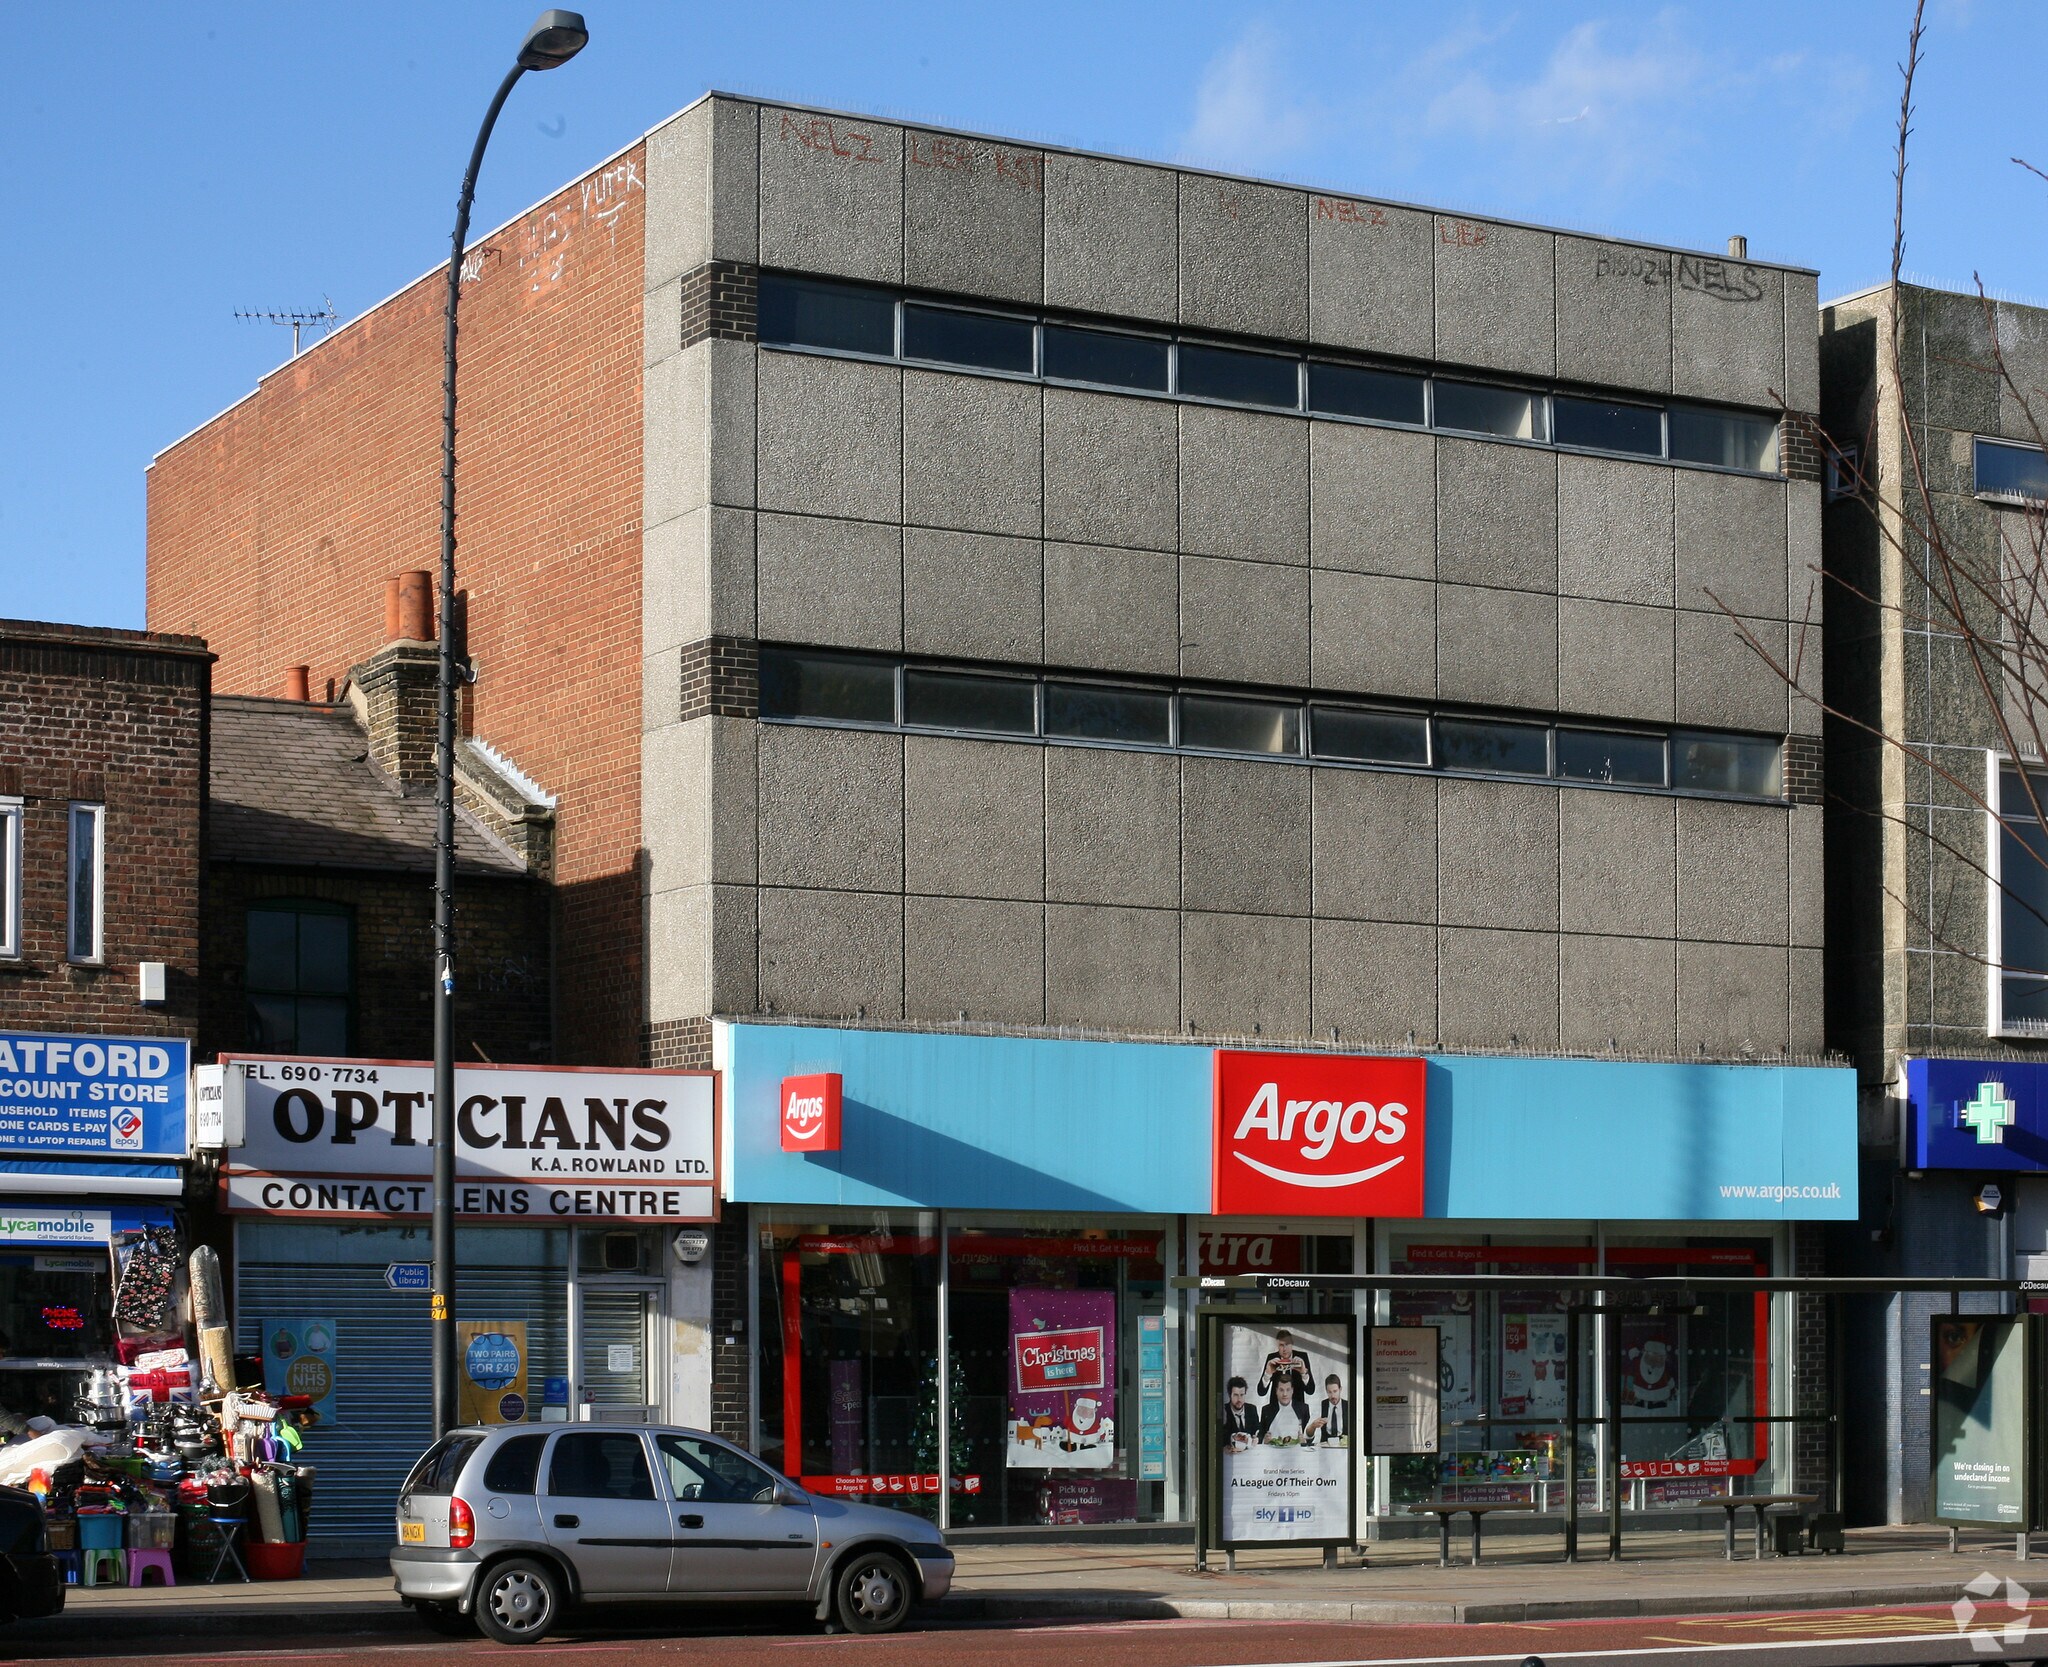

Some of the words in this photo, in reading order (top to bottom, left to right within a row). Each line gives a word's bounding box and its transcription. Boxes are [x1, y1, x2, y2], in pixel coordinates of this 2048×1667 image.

[0, 1040, 170, 1079] ATFORD
[244, 1064, 276, 1080] EL.
[0, 1079, 82, 1100] COUNT
[88, 1082, 169, 1103] STORE
[69, 1108, 107, 1118] ITEMS
[786, 1091, 823, 1127] Argos
[273, 1087, 672, 1152] OPTCIANS
[1233, 1082, 1409, 1160] Argos
[28, 1121, 70, 1131] CARDS
[73, 1123, 108, 1133] E-PAY
[27, 1136, 65, 1145] LAPTOP
[67, 1137, 107, 1146] REPAIRS
[115, 1138, 139, 1147] epay
[572, 1157, 666, 1174] ROWLAND
[675, 1159, 709, 1174] LTD.
[1719, 1182, 1842, 1203] www.argos.co.uk
[262, 1182, 426, 1212] CONTACT
[549, 1189, 681, 1216] CENTRE
[0, 1216, 95, 1233] Lycamobile
[1073, 1243, 1089, 1252] Find
[1099, 1243, 1112, 1252] Get
[1122, 1245, 1143, 1255] Argos
[1411, 1250, 1427, 1258] Find
[1436, 1250, 1448, 1258] Get
[1457, 1250, 1476, 1259] Argos
[45, 1258, 95, 1268] Lycamobile
[399, 1268, 425, 1276] Public
[398, 1277, 425, 1286] library
[1266, 1277, 1310, 1288] JCDecaux
[42, 1308, 79, 1318] PHONE
[49, 1318, 84, 1329] CARDS
[1506, 1325, 1520, 1334] Only
[469, 1350, 490, 1358] TWO
[491, 1350, 516, 1358] PAIRS
[1022, 1344, 1096, 1367] Christmas
[293, 1363, 326, 1373] FREE
[469, 1363, 493, 1373] FOR
[496, 1363, 517, 1374] £49
[1047, 1366, 1055, 1376] is
[1055, 1365, 1074, 1375] here
[292, 1373, 327, 1387] NHS
[1954, 1462, 1972, 1471] We're
[1973, 1462, 1994, 1474] closing
[1995, 1463, 2002, 1472] in
[1231, 1478, 1238, 1487] A
[1240, 1478, 1274, 1489] League
[1276, 1477, 1288, 1487] Of
[1289, 1477, 1314, 1487] Their
[1316, 1477, 1337, 1487] Own
[1954, 1473, 1987, 1482] undeclared
[1988, 1474, 2011, 1483] income
[1059, 1485, 1076, 1493] Pick
[1078, 1486, 1088, 1495] up
[1487, 1487, 1496, 1495] up
[1058, 1497, 1078, 1506] copy
[1080, 1495, 1103, 1506] today
[1463, 1494, 1477, 1502] take
[1489, 1494, 1496, 1502] to
[1256, 1508, 1276, 1521] sky
[1296, 1510, 1312, 1519] HD
